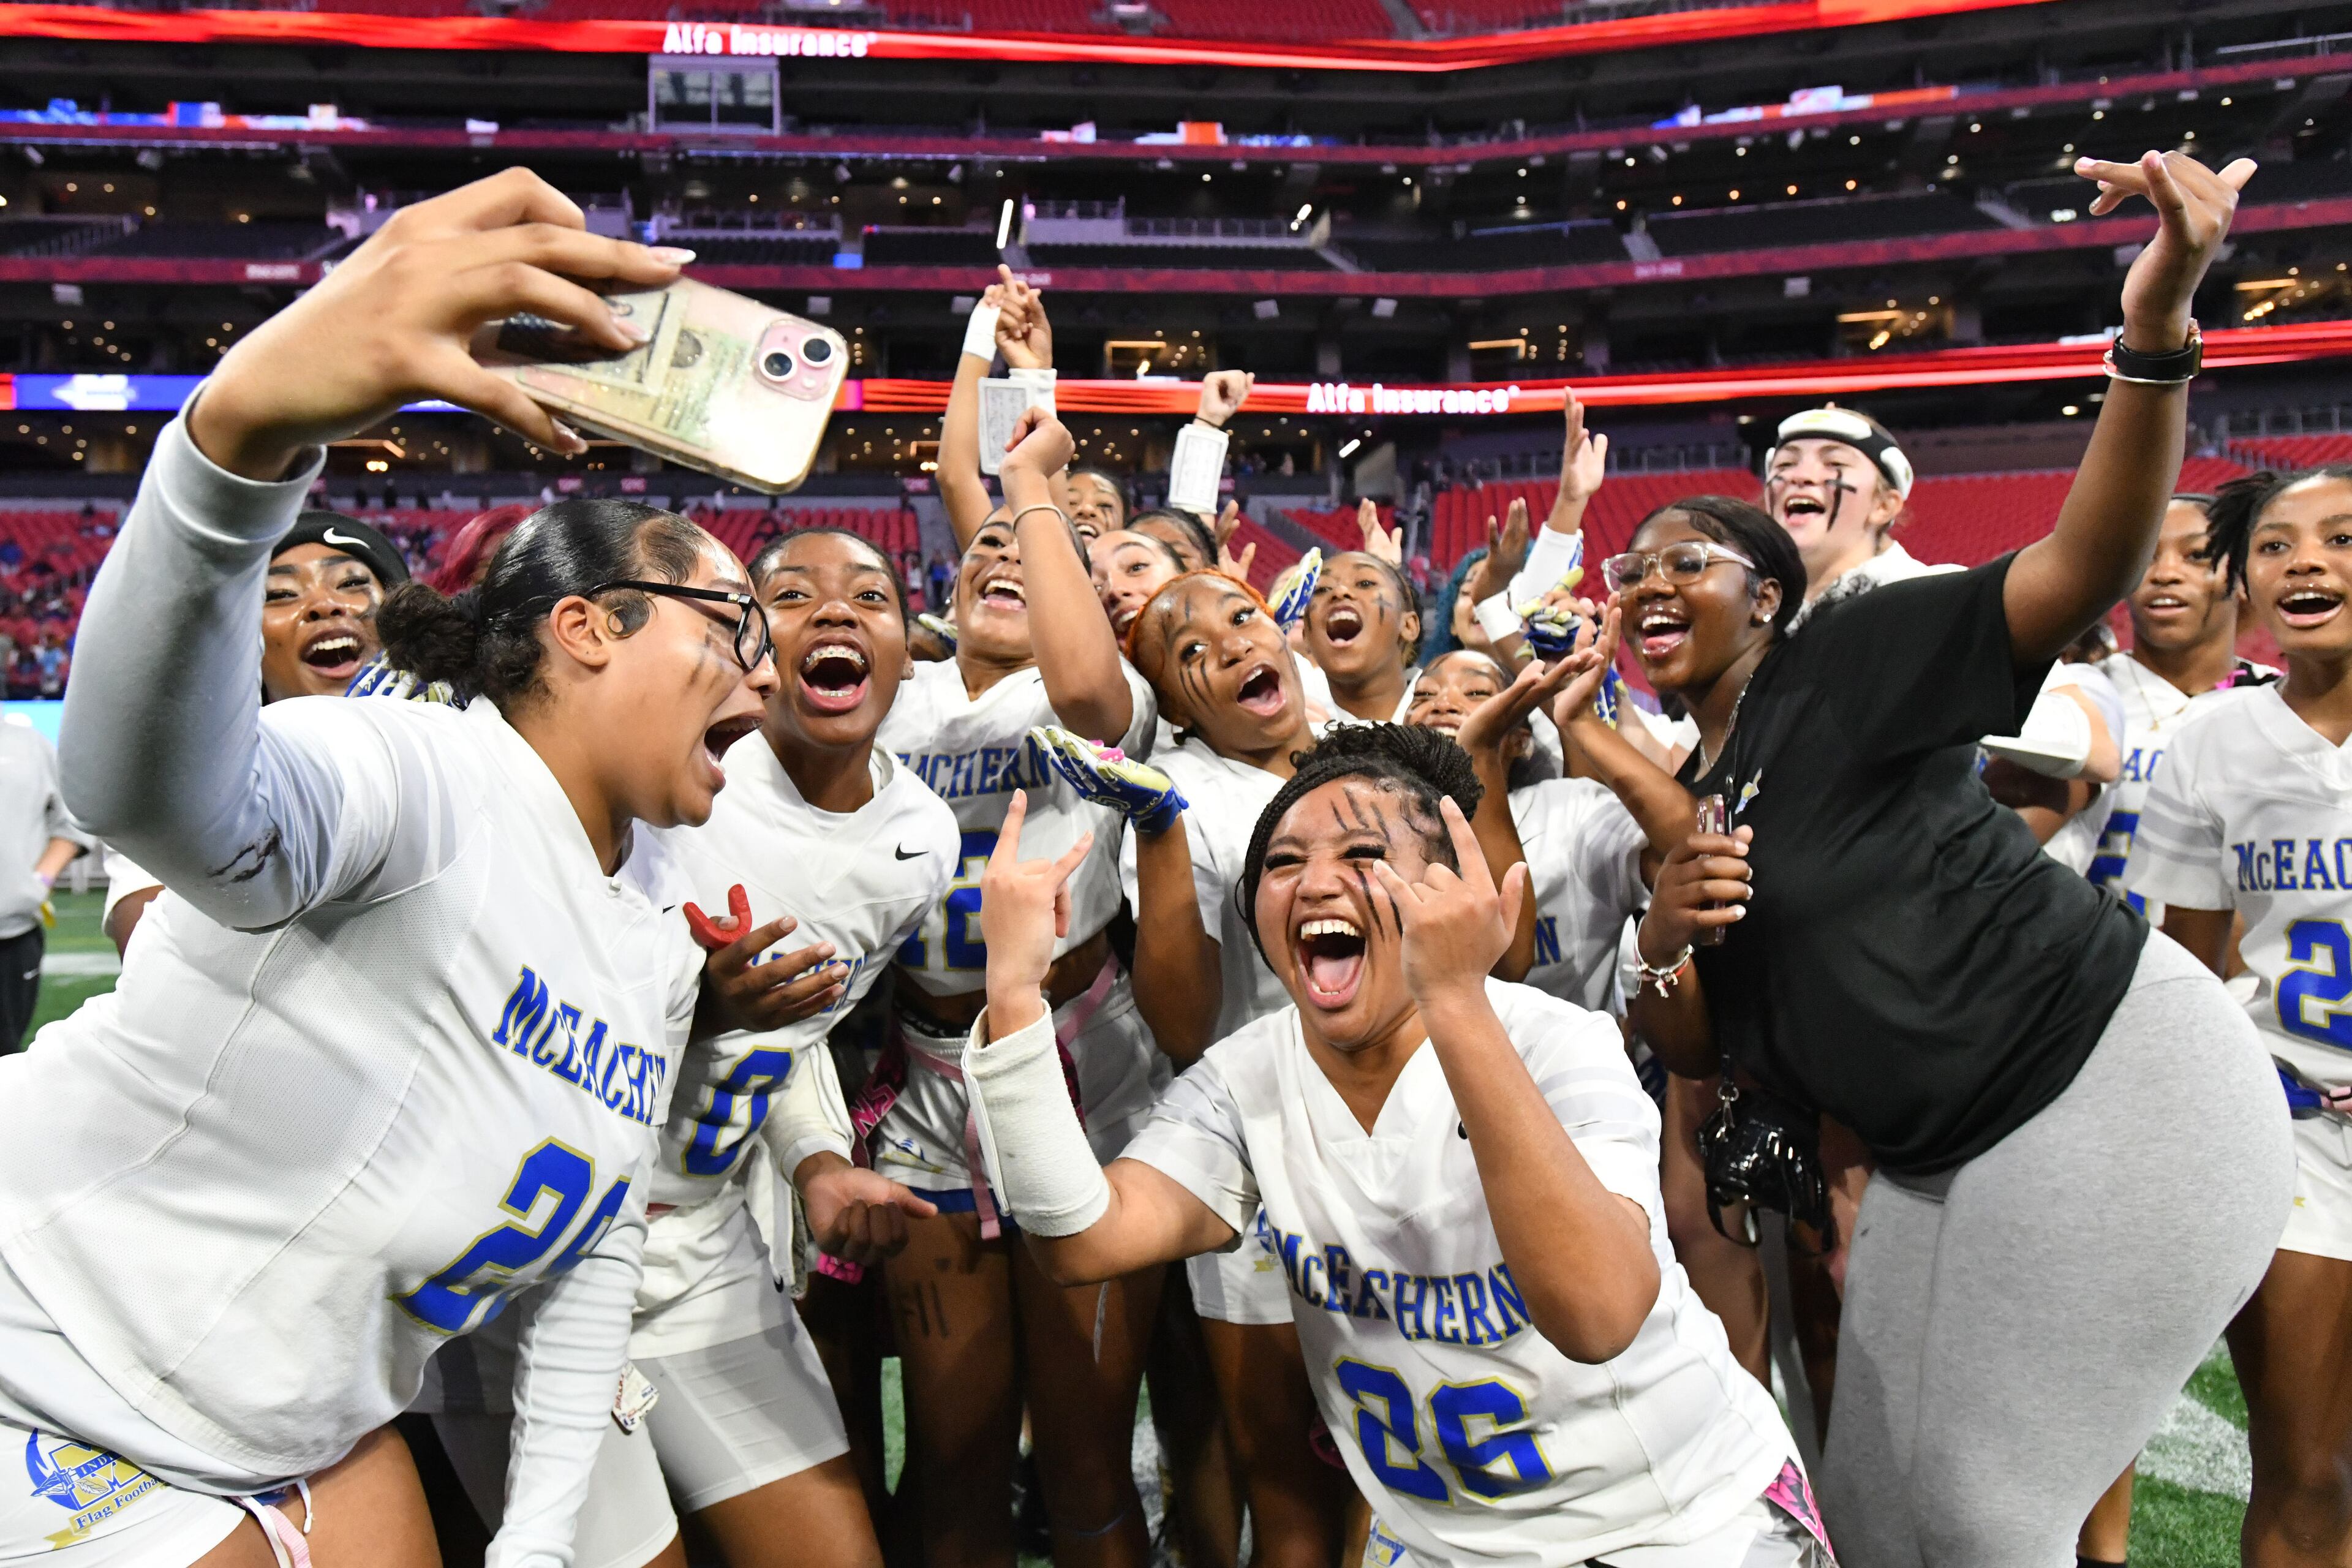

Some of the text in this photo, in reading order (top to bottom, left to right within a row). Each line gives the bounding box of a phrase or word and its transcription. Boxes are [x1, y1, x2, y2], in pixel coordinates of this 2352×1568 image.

[663, 23, 868, 58] Alfa Insurance
[1306, 383, 1509, 414] Alfa Insurance
[2231, 838, 2352, 891] McEAC
[680, 1045, 795, 1179] 0
[1333, 1355, 1556, 1509] 26
[75, 1477, 160, 1529] Flag Footba
